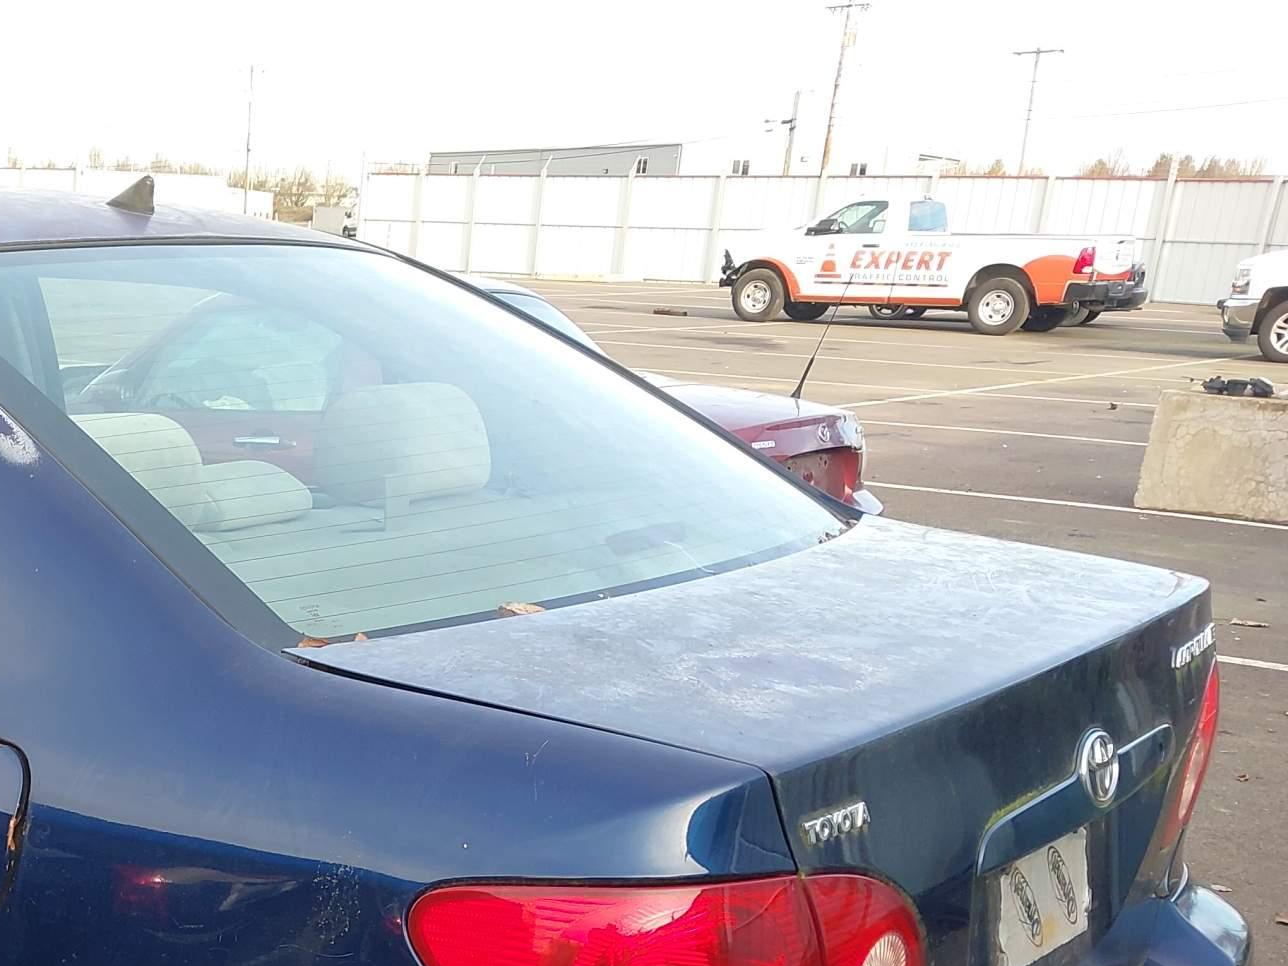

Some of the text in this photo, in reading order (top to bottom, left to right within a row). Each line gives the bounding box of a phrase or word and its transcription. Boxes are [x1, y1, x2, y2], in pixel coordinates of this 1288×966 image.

[849, 250, 952, 271] EXPERT
[848, 272, 949, 282] TRAFFIC CONTROL
[801, 801, 872, 845] TOYOTA
